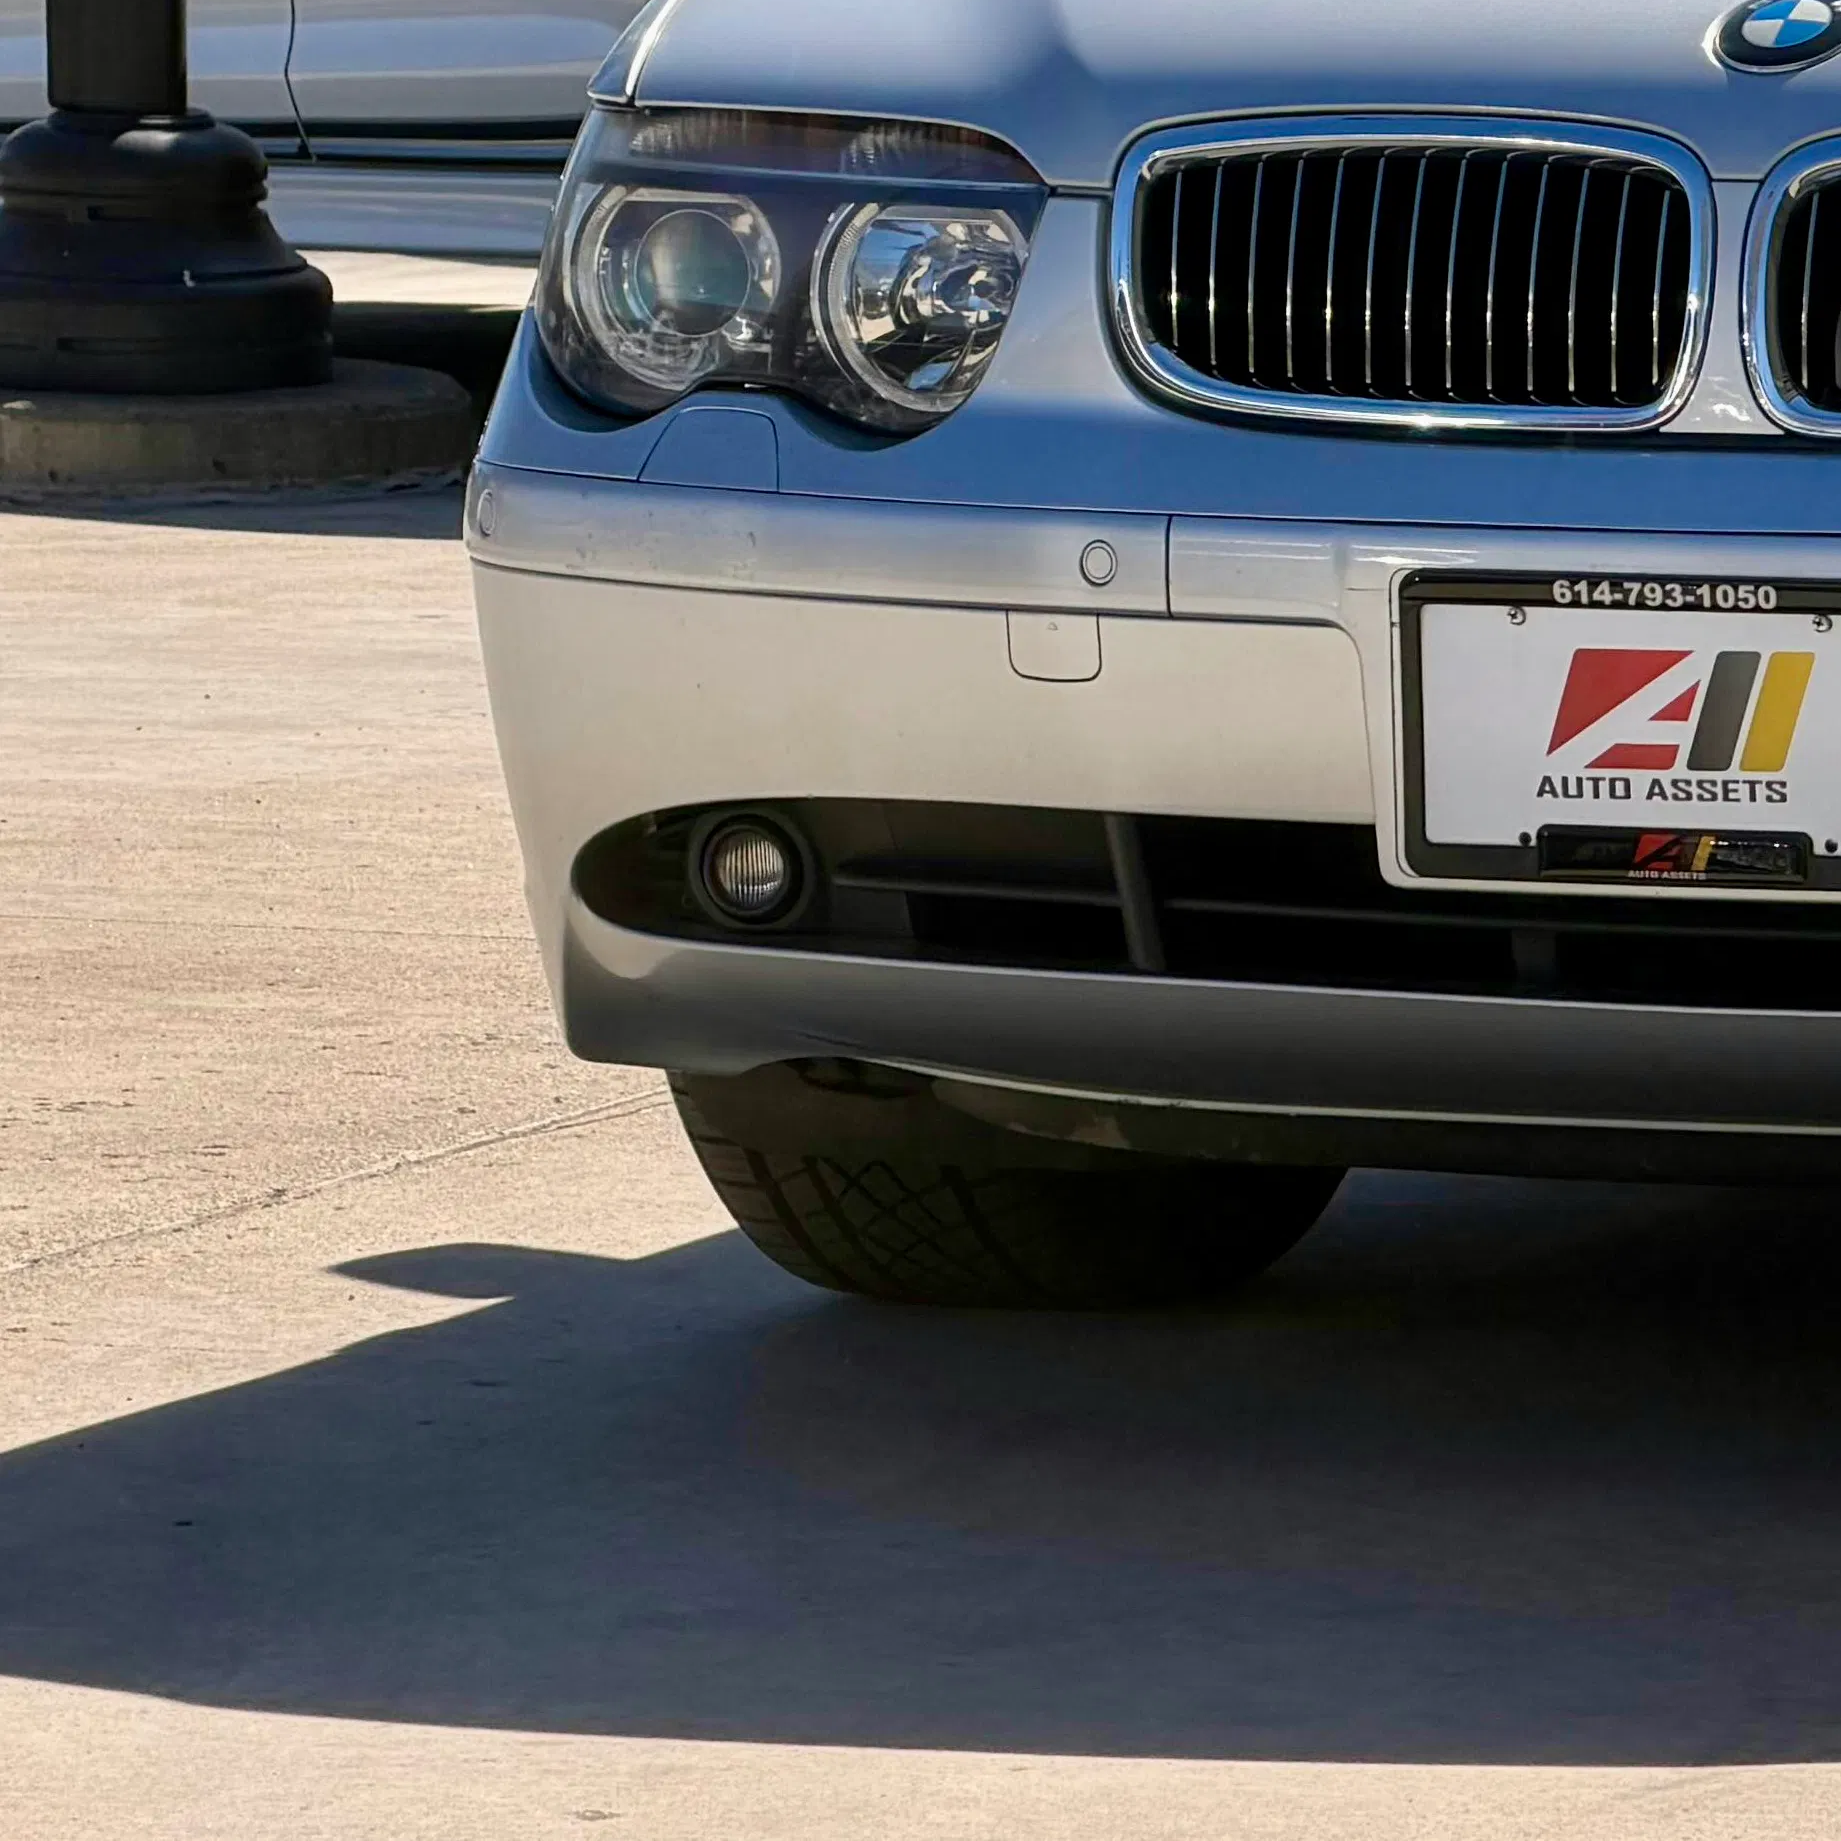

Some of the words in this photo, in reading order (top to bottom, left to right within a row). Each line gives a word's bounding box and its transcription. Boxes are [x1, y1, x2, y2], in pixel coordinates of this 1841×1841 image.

[1552, 579, 1778, 610] 614-793-1050
[1536, 775, 1632, 800] AUTO
[1645, 778, 1788, 804] ASSETS
[1627, 869, 1660, 879] AUTO
[1661, 870, 1708, 881] ASSETS
